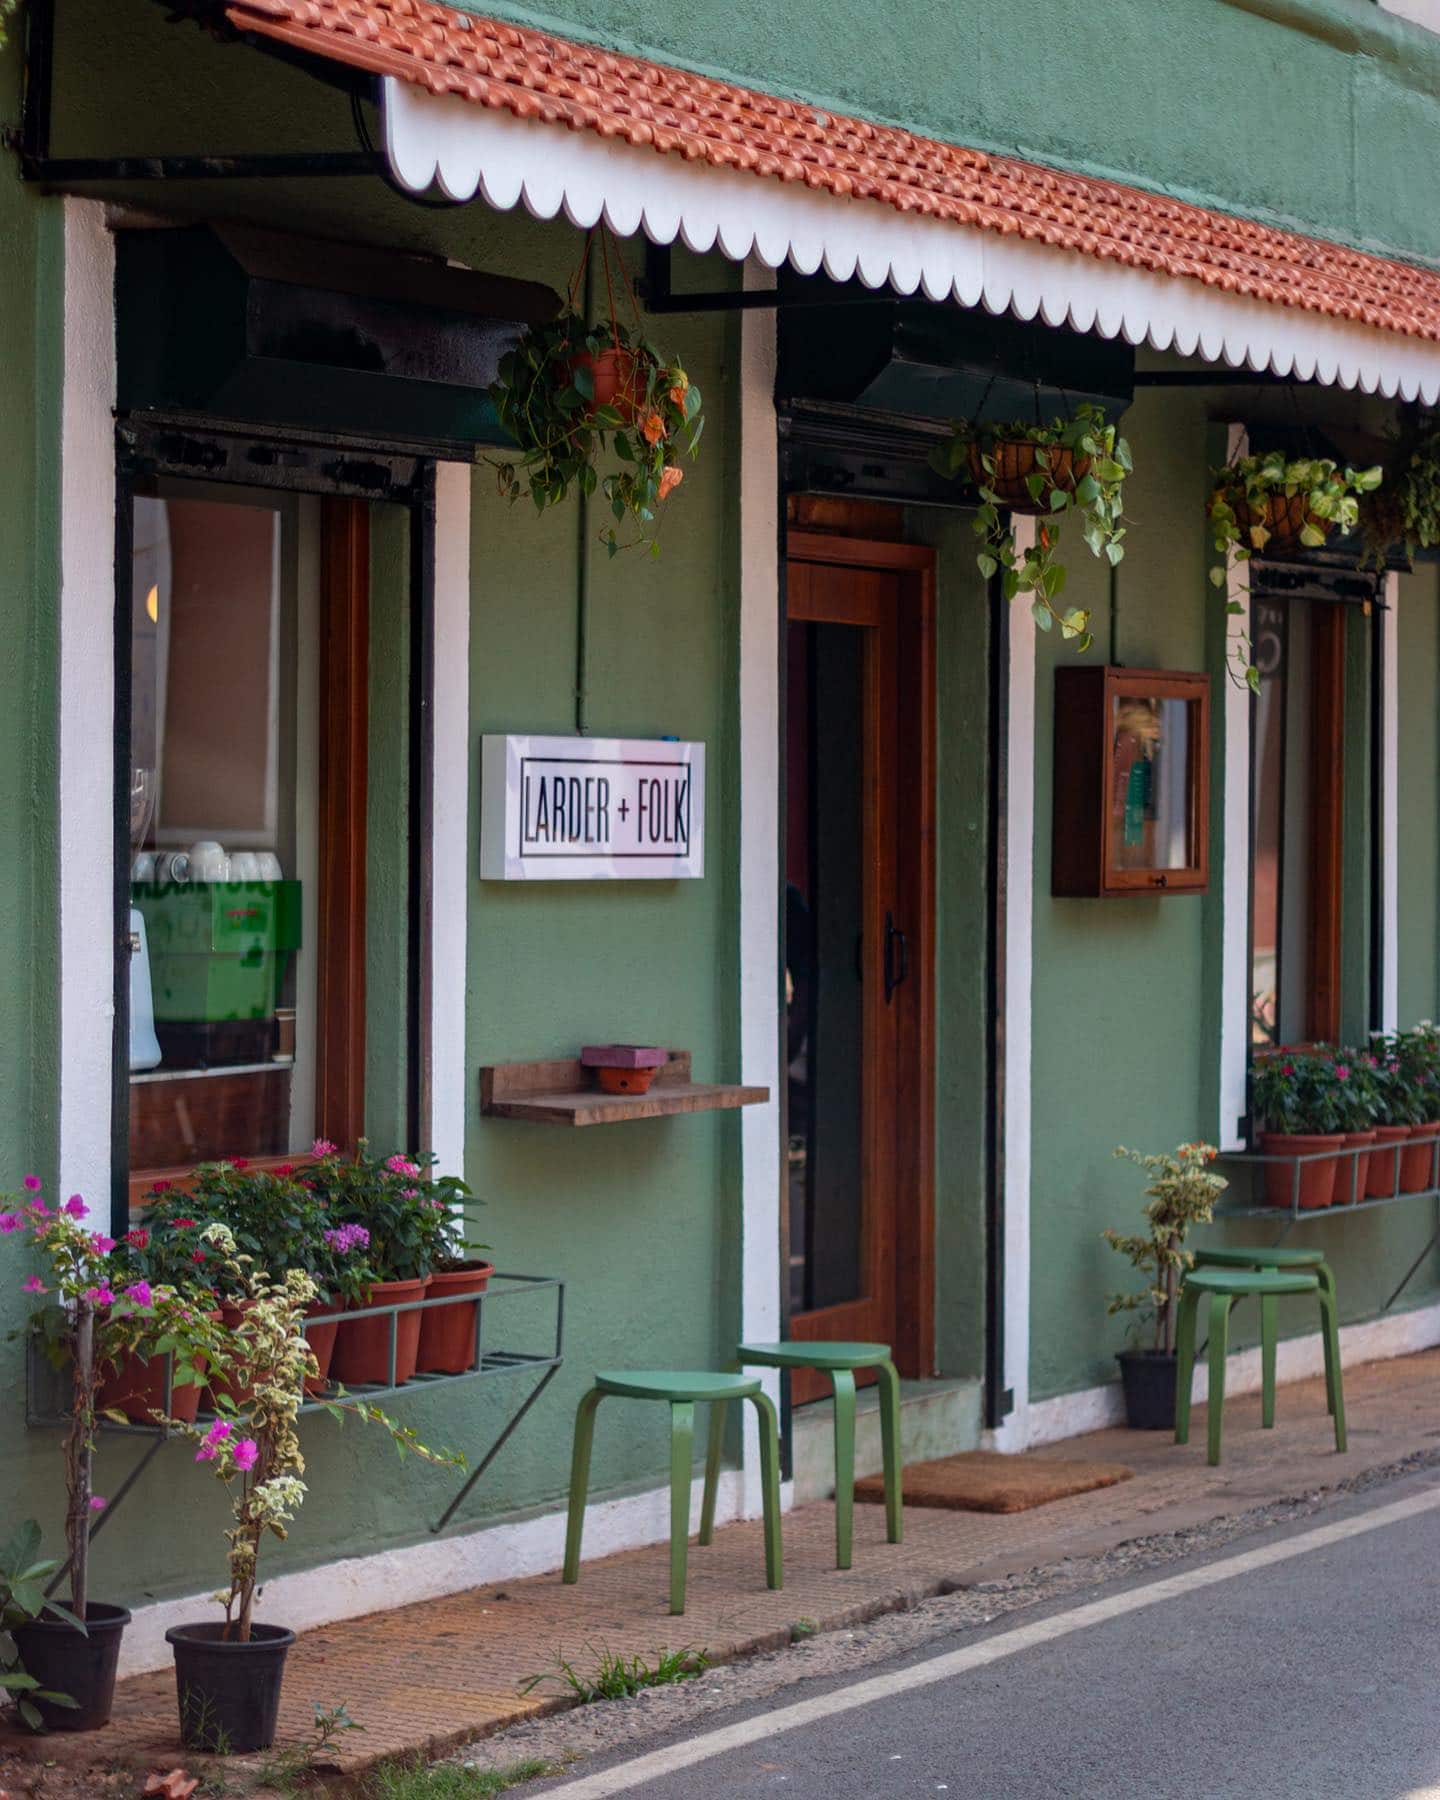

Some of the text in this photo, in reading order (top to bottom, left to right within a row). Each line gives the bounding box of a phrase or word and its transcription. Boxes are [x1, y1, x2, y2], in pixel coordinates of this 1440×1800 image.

[525, 776, 687, 843] LARDER + FOLK
